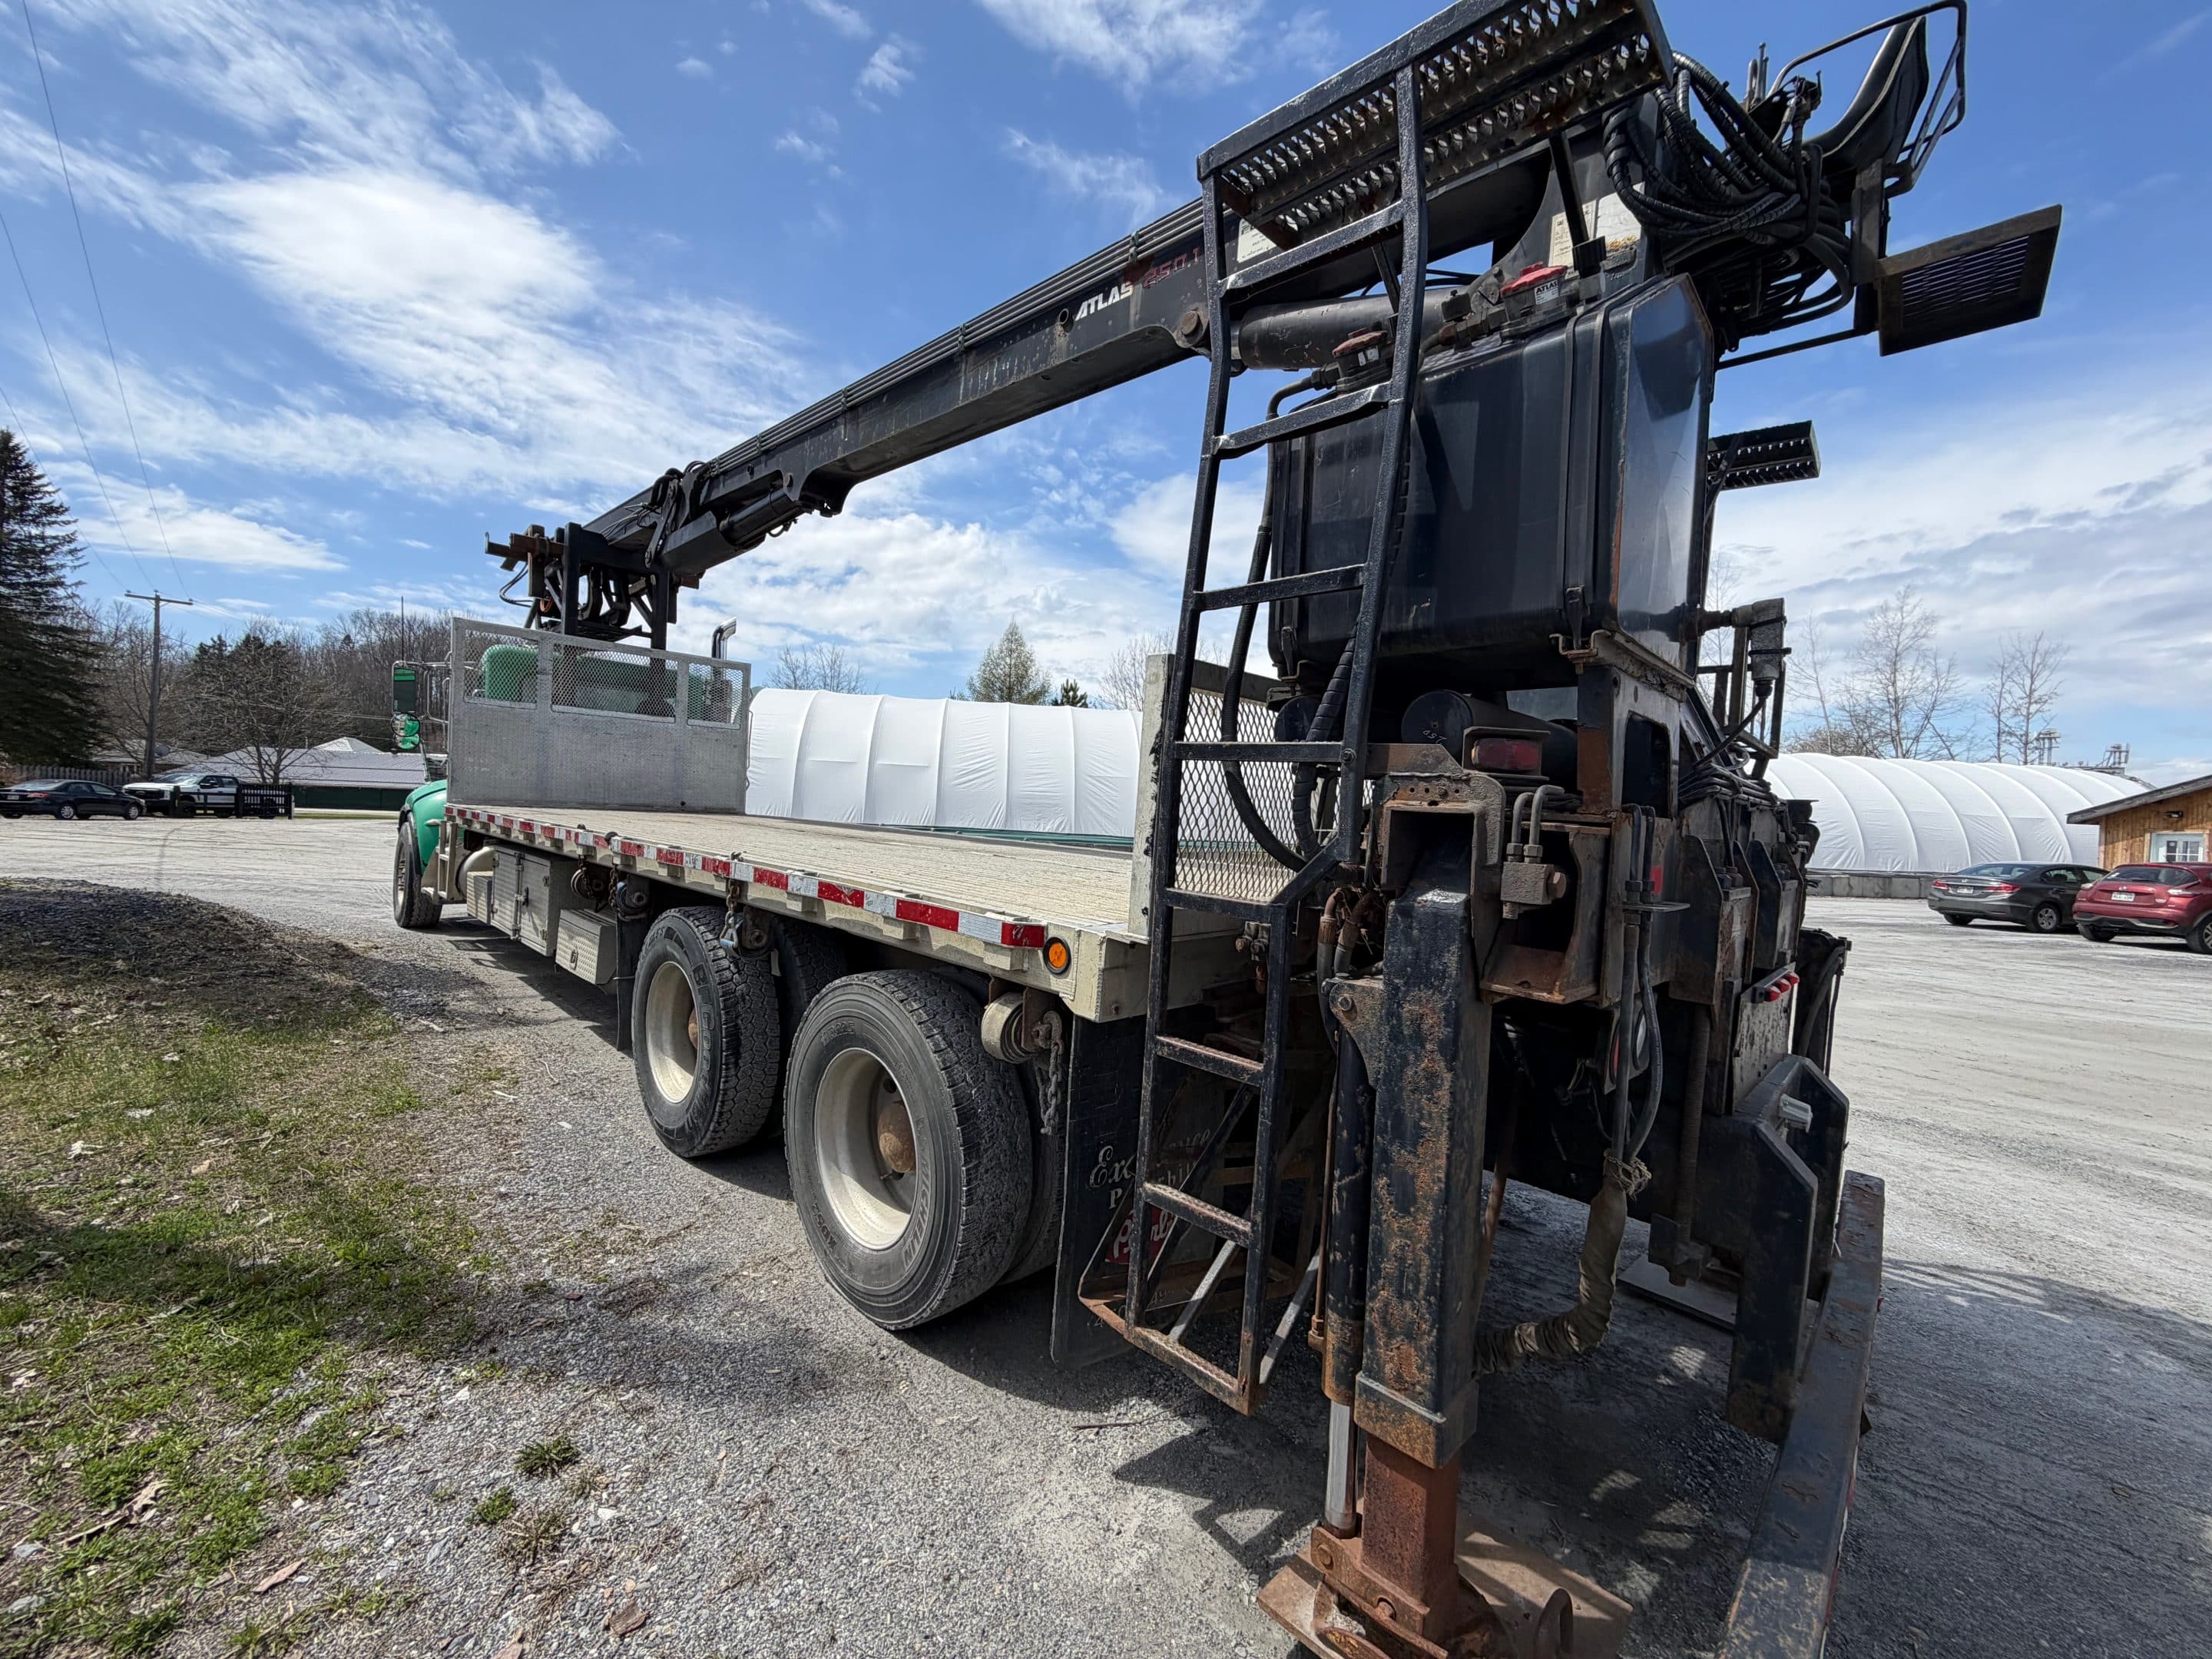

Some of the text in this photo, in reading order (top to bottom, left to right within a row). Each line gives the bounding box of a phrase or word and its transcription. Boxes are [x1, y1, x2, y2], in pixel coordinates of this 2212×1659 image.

[1075, 281, 1134, 321] ATLAS
[1536, 281, 1557, 293] ATLAS
[903, 1158, 930, 1268] MICHELIN
